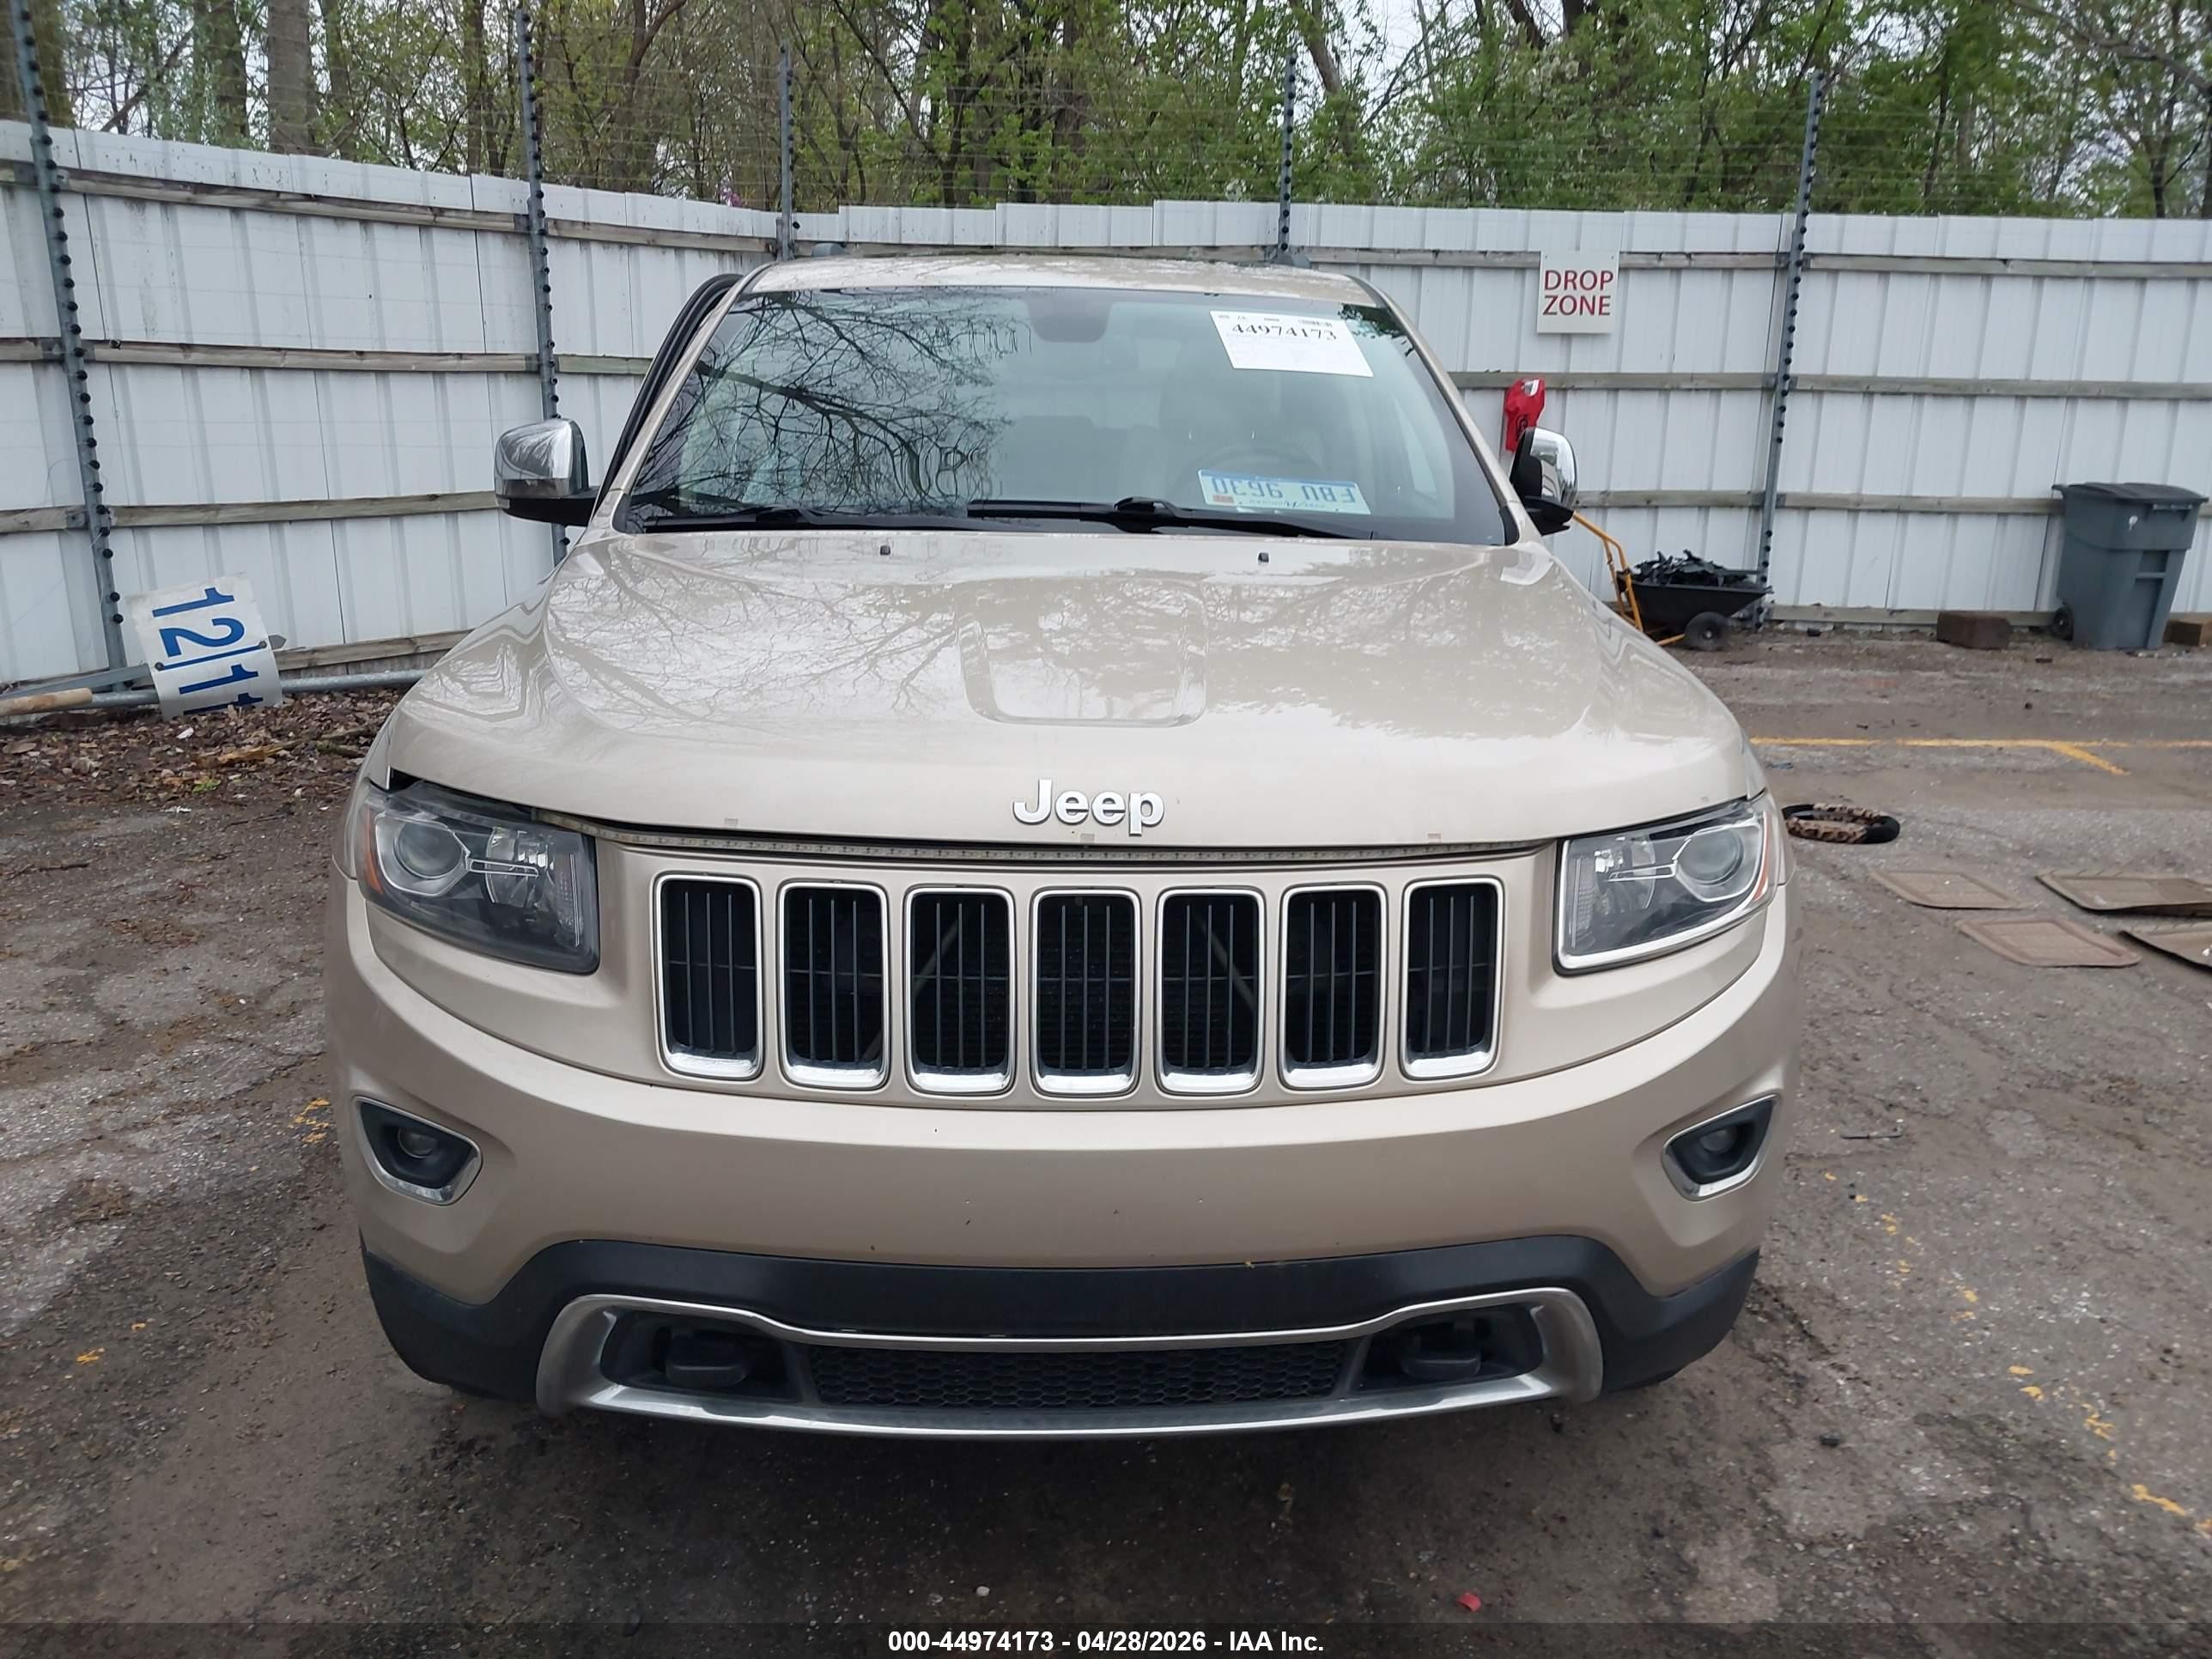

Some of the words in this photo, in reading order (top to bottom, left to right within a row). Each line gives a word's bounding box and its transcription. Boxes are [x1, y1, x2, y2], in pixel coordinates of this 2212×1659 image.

[1544, 270, 1614, 291] DROP
[1542, 295, 1611, 316] ZONE
[1231, 323, 1337, 341] 44974173
[1012, 778, 1165, 837] Jeep
